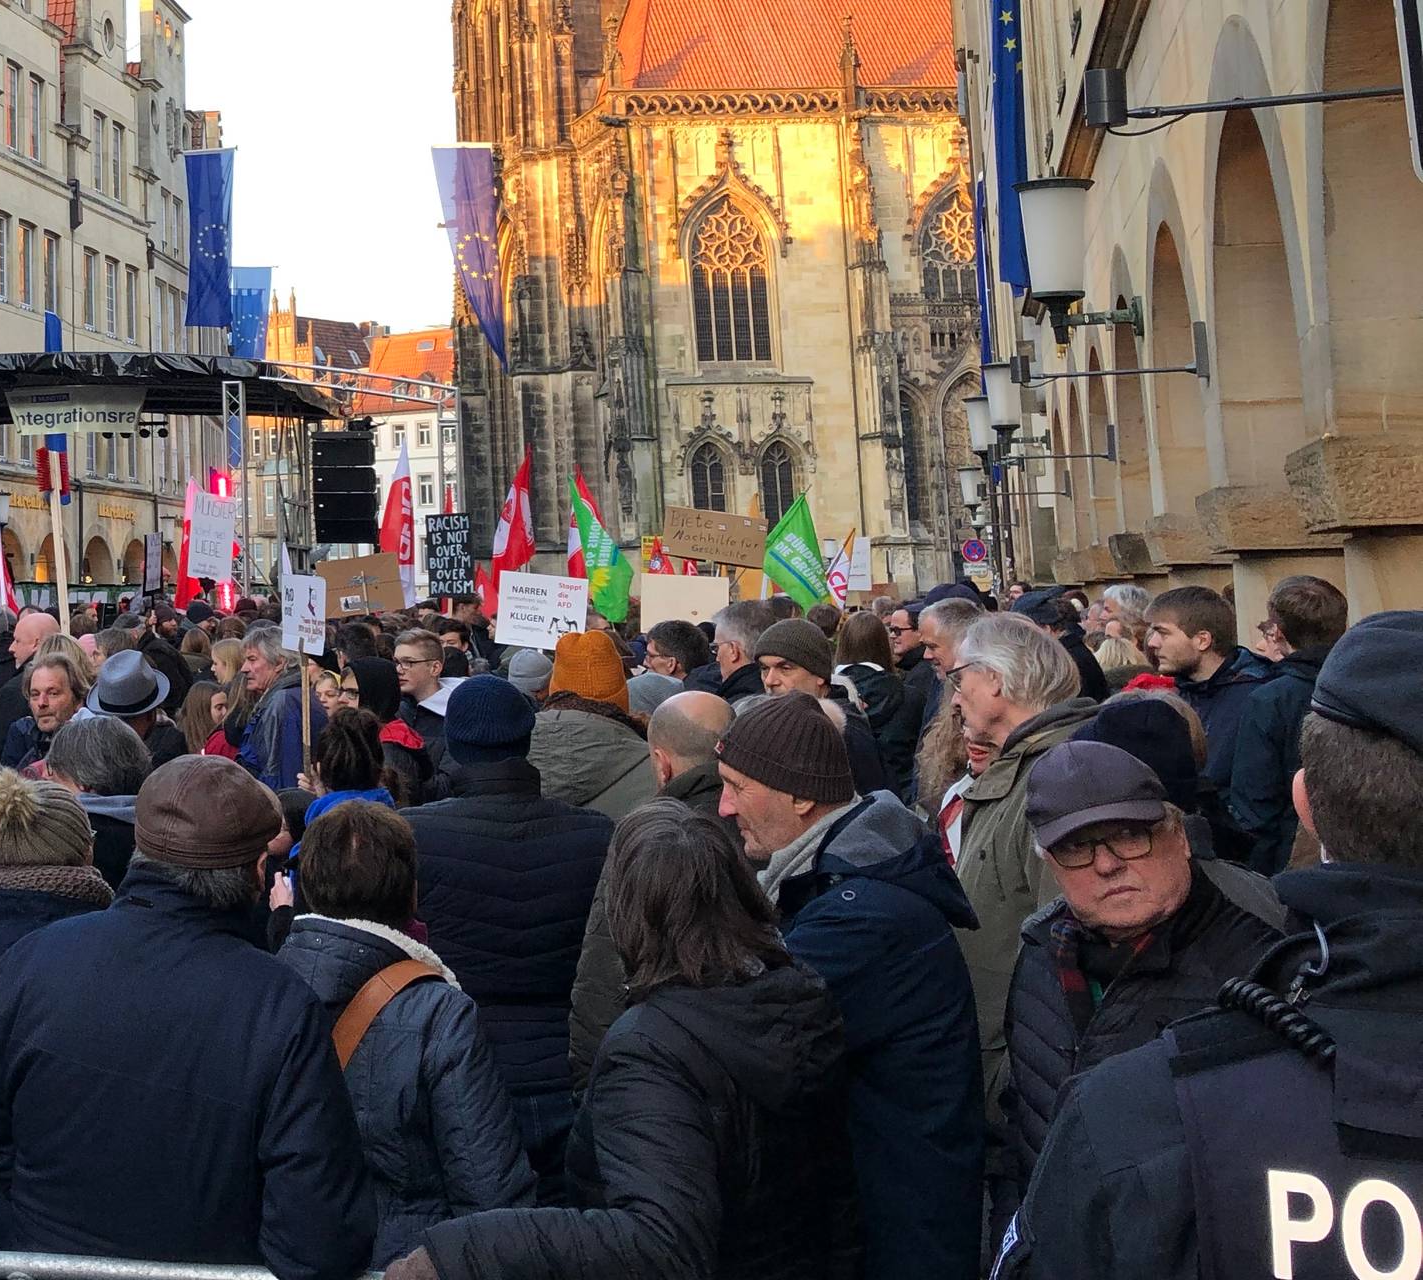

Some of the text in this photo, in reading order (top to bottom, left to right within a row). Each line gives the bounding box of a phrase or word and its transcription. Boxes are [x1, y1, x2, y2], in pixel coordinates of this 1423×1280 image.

[427, 515, 469, 532] RACISM
[672, 510, 713, 529] Biete
[432, 530, 469, 545] IS NOT
[673, 530, 736, 547] Nachhilfe
[437, 544, 467, 557] OVER.
[774, 542, 793, 557] DIE
[429, 555, 471, 569] BUT I'M
[437, 569, 466, 580] OVER
[512, 586, 547, 596] NARREN
[559, 583, 582, 591] Stoppt
[510, 612, 545, 623] KLUGEN
[1268, 1170, 1422, 1280] PO
